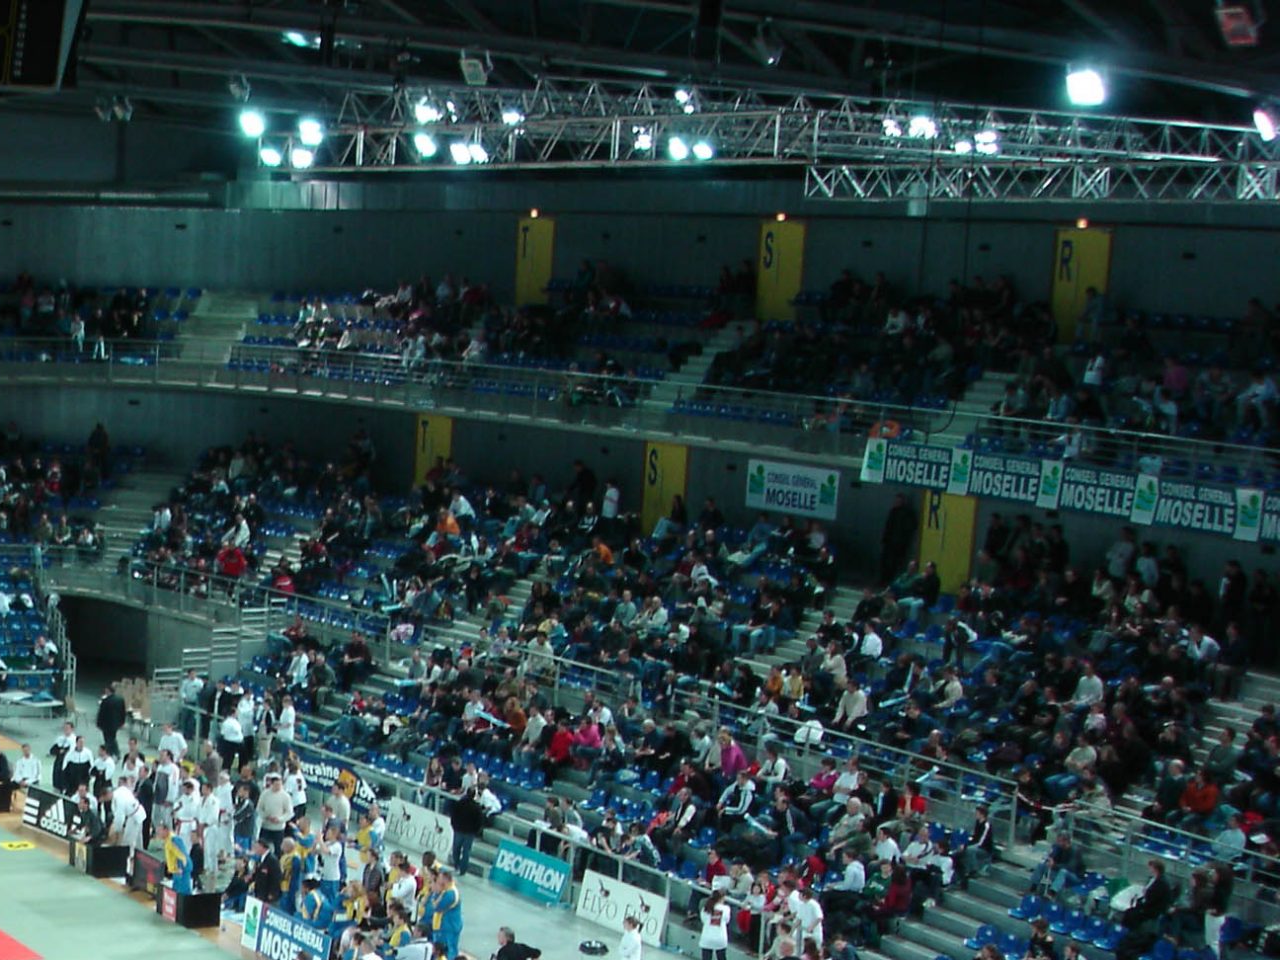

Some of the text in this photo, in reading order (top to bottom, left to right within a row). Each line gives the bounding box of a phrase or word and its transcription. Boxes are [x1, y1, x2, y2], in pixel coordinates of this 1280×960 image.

[522, 226, 529, 258] T
[763, 231, 774, 269] S
[1059, 241, 1072, 282] R
[422, 420, 429, 453] T
[648, 448, 658, 485] S
[885, 458, 950, 488] MOSELLE
[765, 488, 817, 511] MOSELLE
[969, 470, 1039, 502] MOSELLE
[1060, 483, 1134, 516] MOSELLE
[928, 490, 941, 530] R
[1155, 498, 1236, 535] MOSELLE
[39, 816, 68, 837] adidas
[495, 849, 565, 893] DECATHLON
